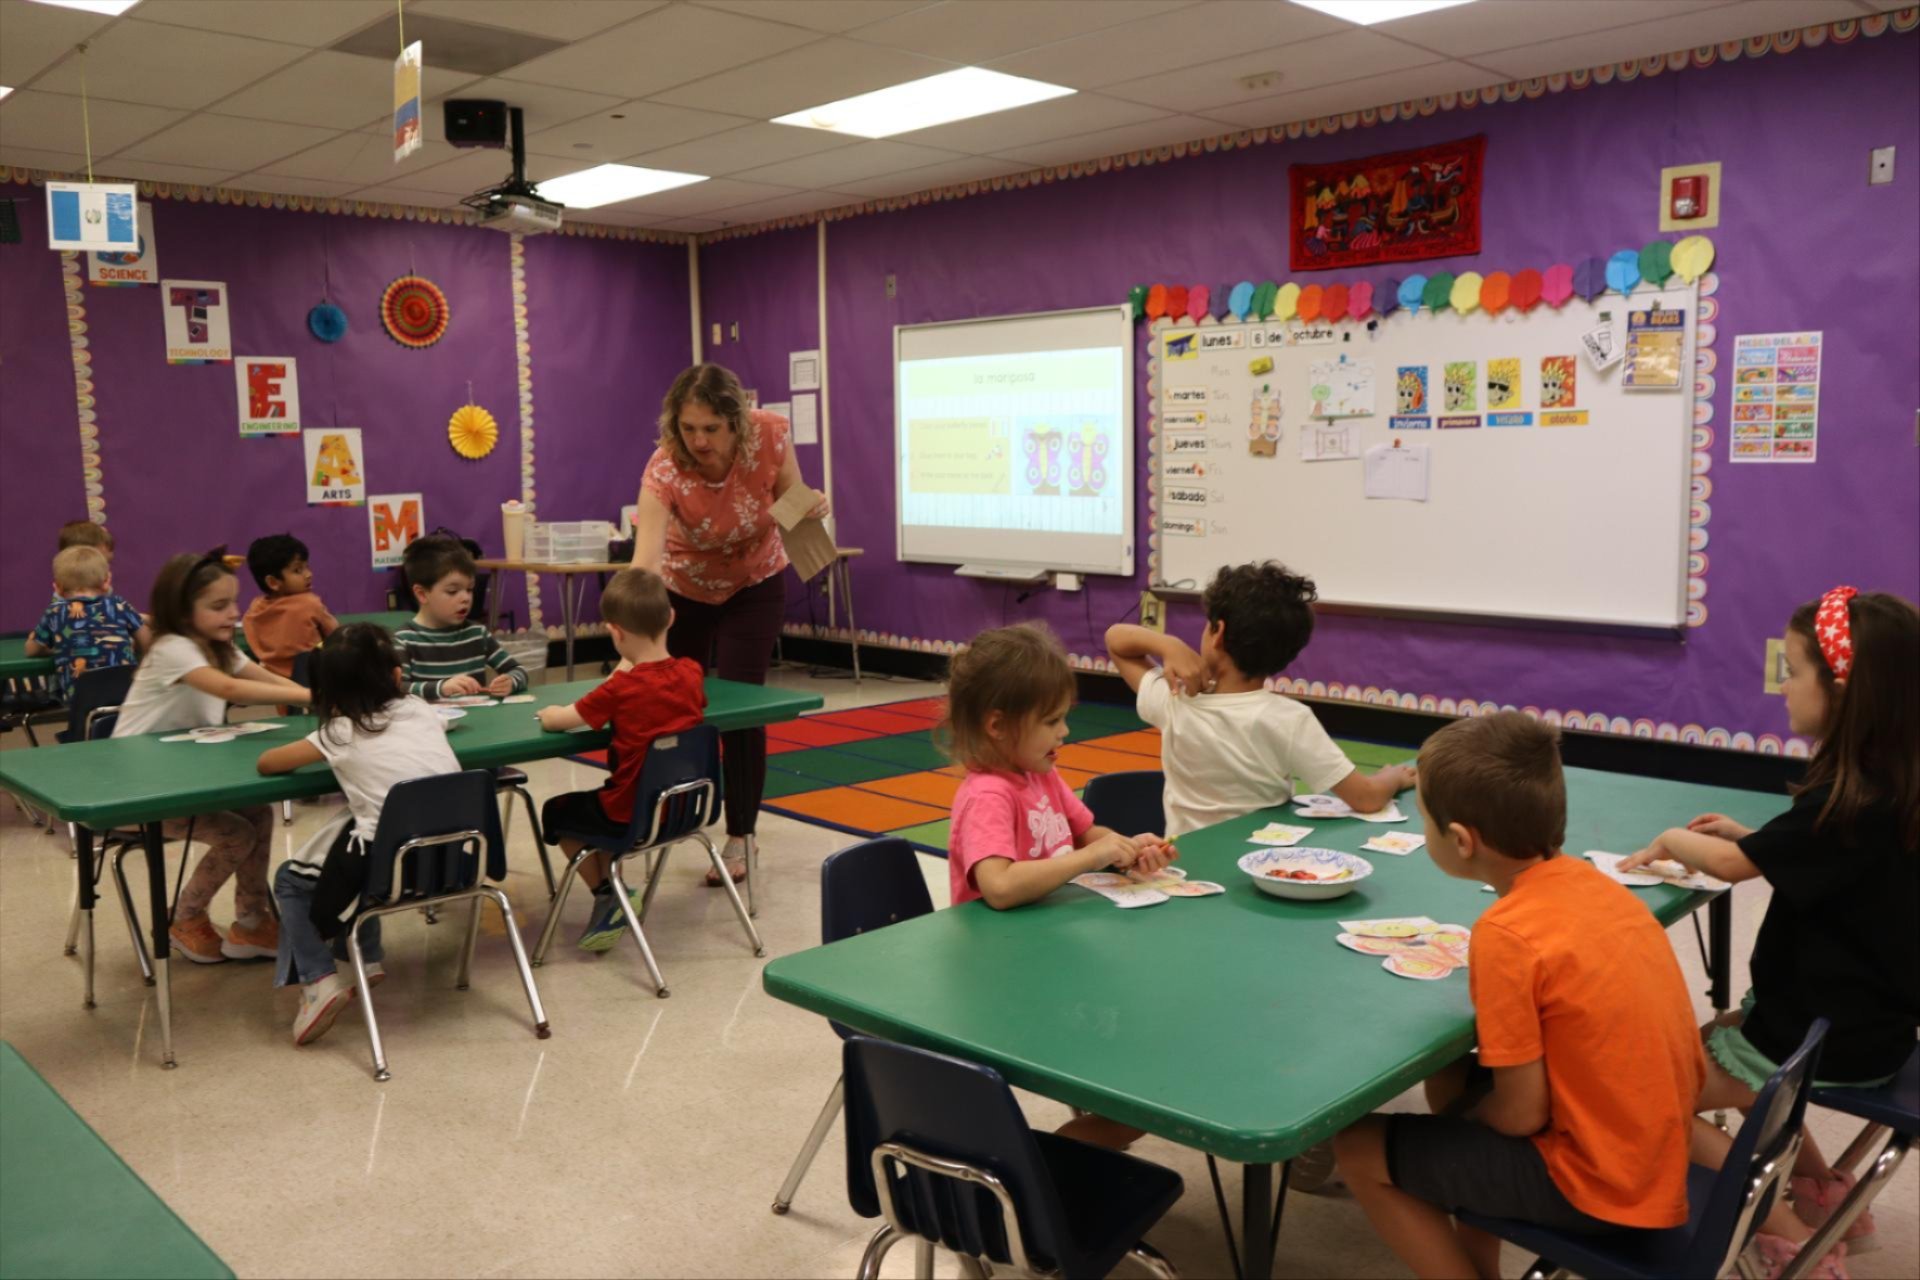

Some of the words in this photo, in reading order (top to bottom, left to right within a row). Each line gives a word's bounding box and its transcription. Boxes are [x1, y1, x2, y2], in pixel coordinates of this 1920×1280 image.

[99, 267, 148, 281] SCIENCE
[169, 287, 220, 343] T
[1202, 335, 1232, 347] lunes
[1254, 333, 1261, 344] 6
[1268, 331, 1282, 343] de
[1293, 328, 1333, 340] octubre
[169, 348, 229, 357] TECHNOLOGY
[247, 363, 286, 418] E
[1173, 391, 1206, 400] martes
[1550, 414, 1578, 424] otoño
[242, 422, 298, 431] ENGINEERING
[1173, 438, 1206, 451] jueves
[311, 434, 361, 487] A
[322, 489, 352, 500] ARTS
[374, 555, 405, 564] MATHEM
